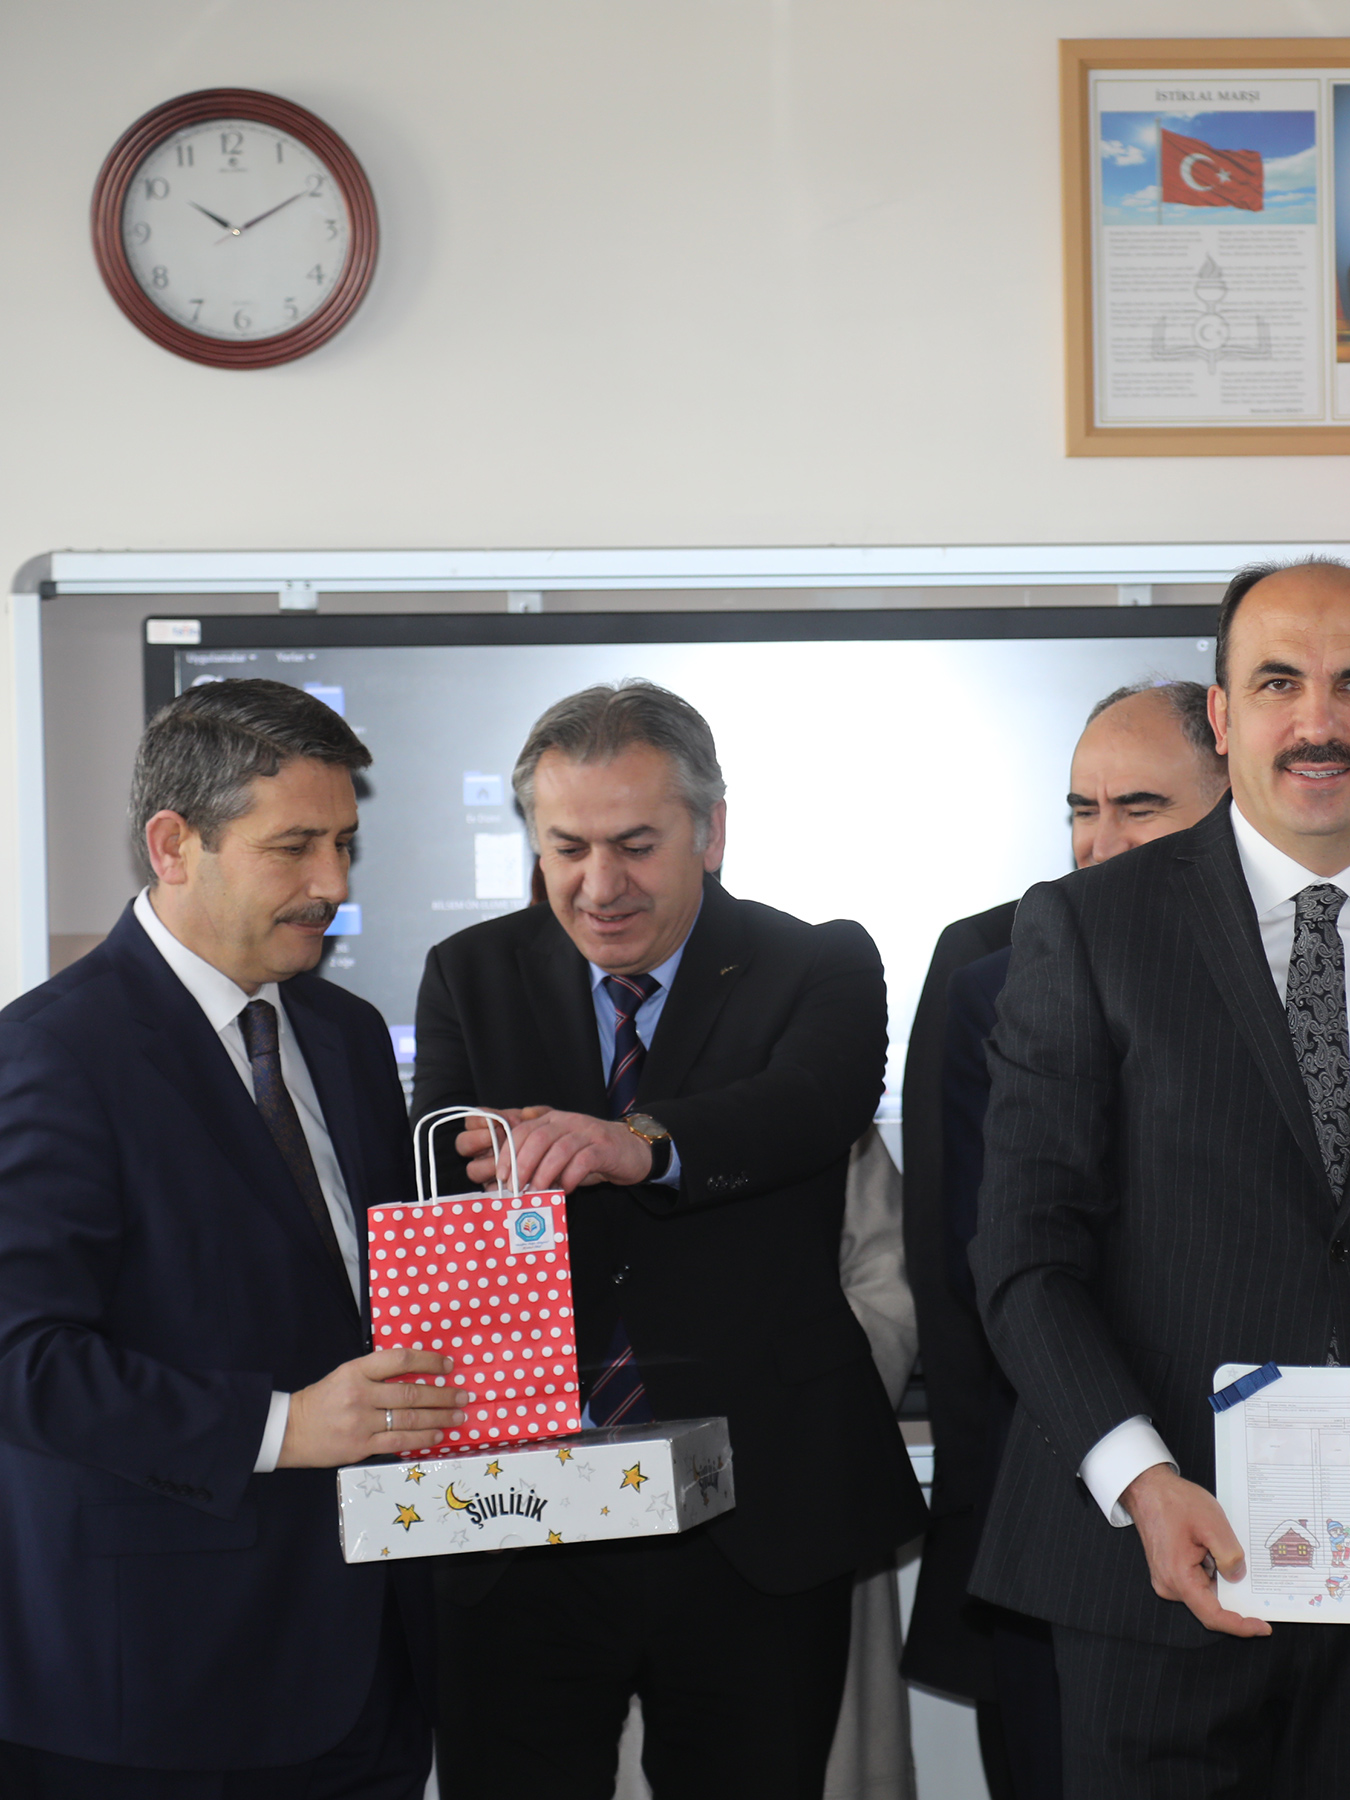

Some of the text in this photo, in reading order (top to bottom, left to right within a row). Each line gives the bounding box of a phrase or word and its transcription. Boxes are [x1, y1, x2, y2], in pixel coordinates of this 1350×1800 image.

[1217, 90, 1260, 103] MARŞI
[220, 130, 244, 156] 12
[275, 141, 284, 164] 1
[177, 144, 194, 167] 11
[144, 176, 170, 200] 10
[305, 173, 324, 197] 2
[131, 221, 151, 246] 9
[324, 219, 338, 242] 3
[151, 264, 169, 290] 8
[306, 263, 325, 286] 4
[189, 299, 205, 324] 7
[233, 309, 251, 332] 6
[284, 296, 298, 321] 5
[465, 1487, 548, 1530] ŞİVLİLİK
